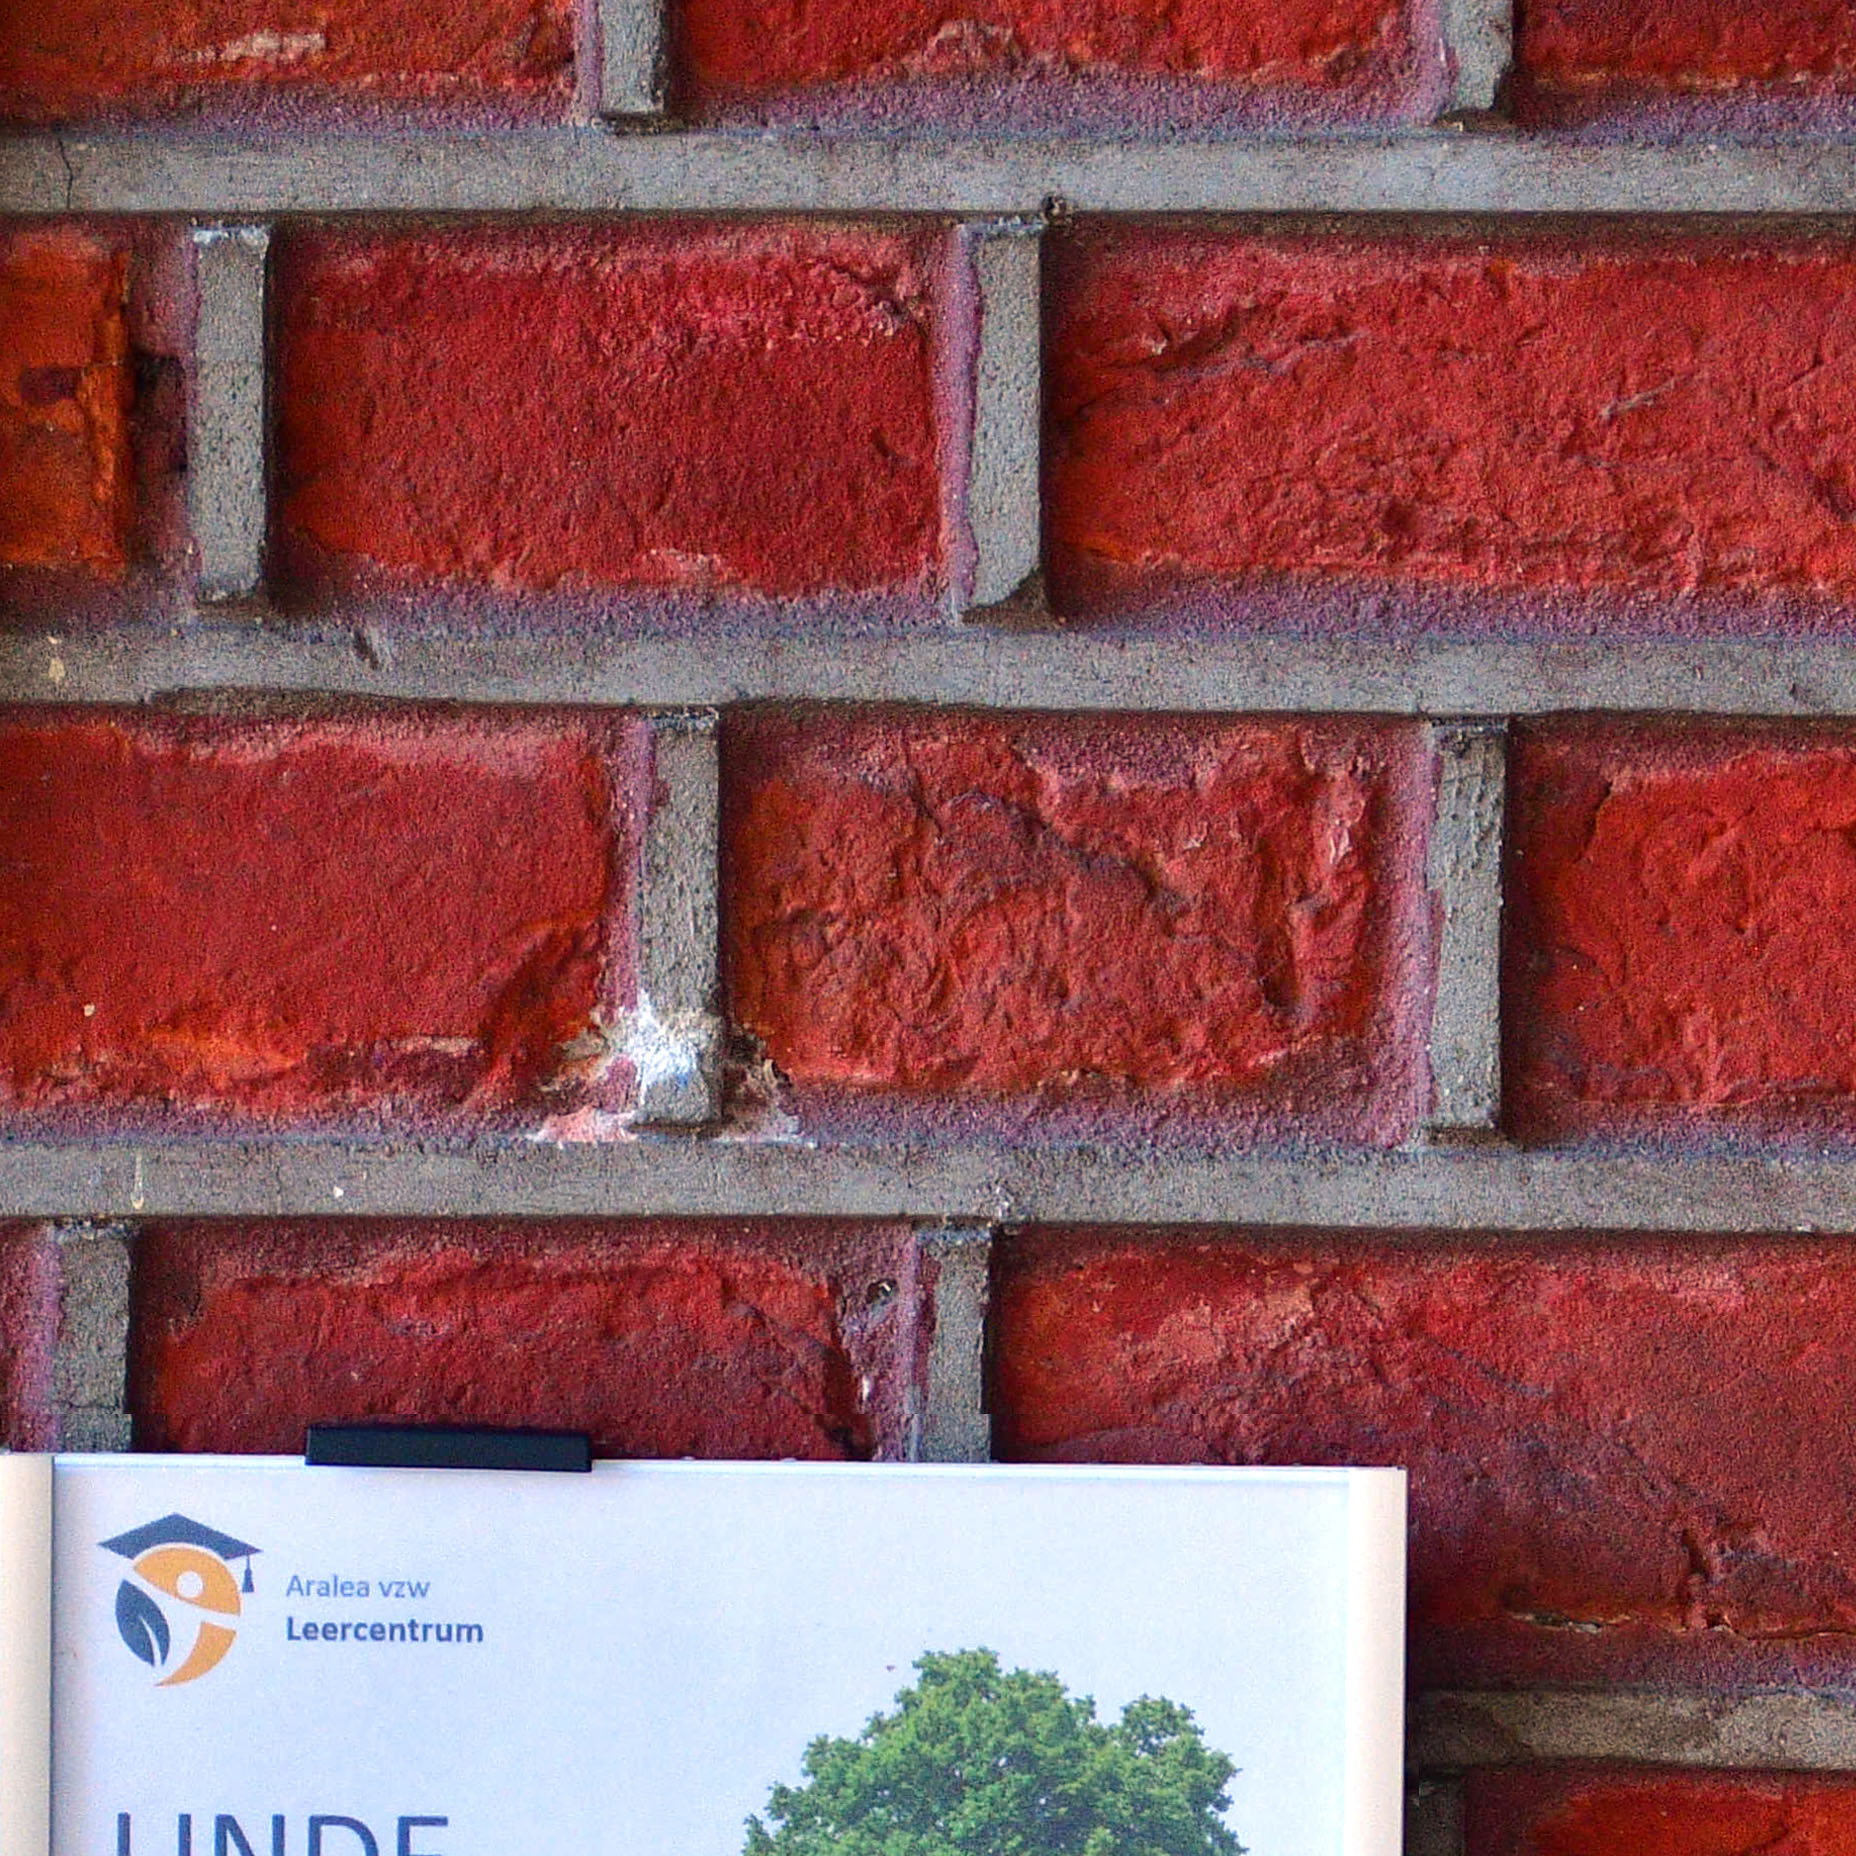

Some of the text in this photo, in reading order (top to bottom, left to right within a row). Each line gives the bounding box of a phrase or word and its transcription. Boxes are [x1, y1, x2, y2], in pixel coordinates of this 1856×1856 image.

[285, 1574, 431, 1599] Aralea vzw
[286, 1615, 485, 1643] Leercentrum
